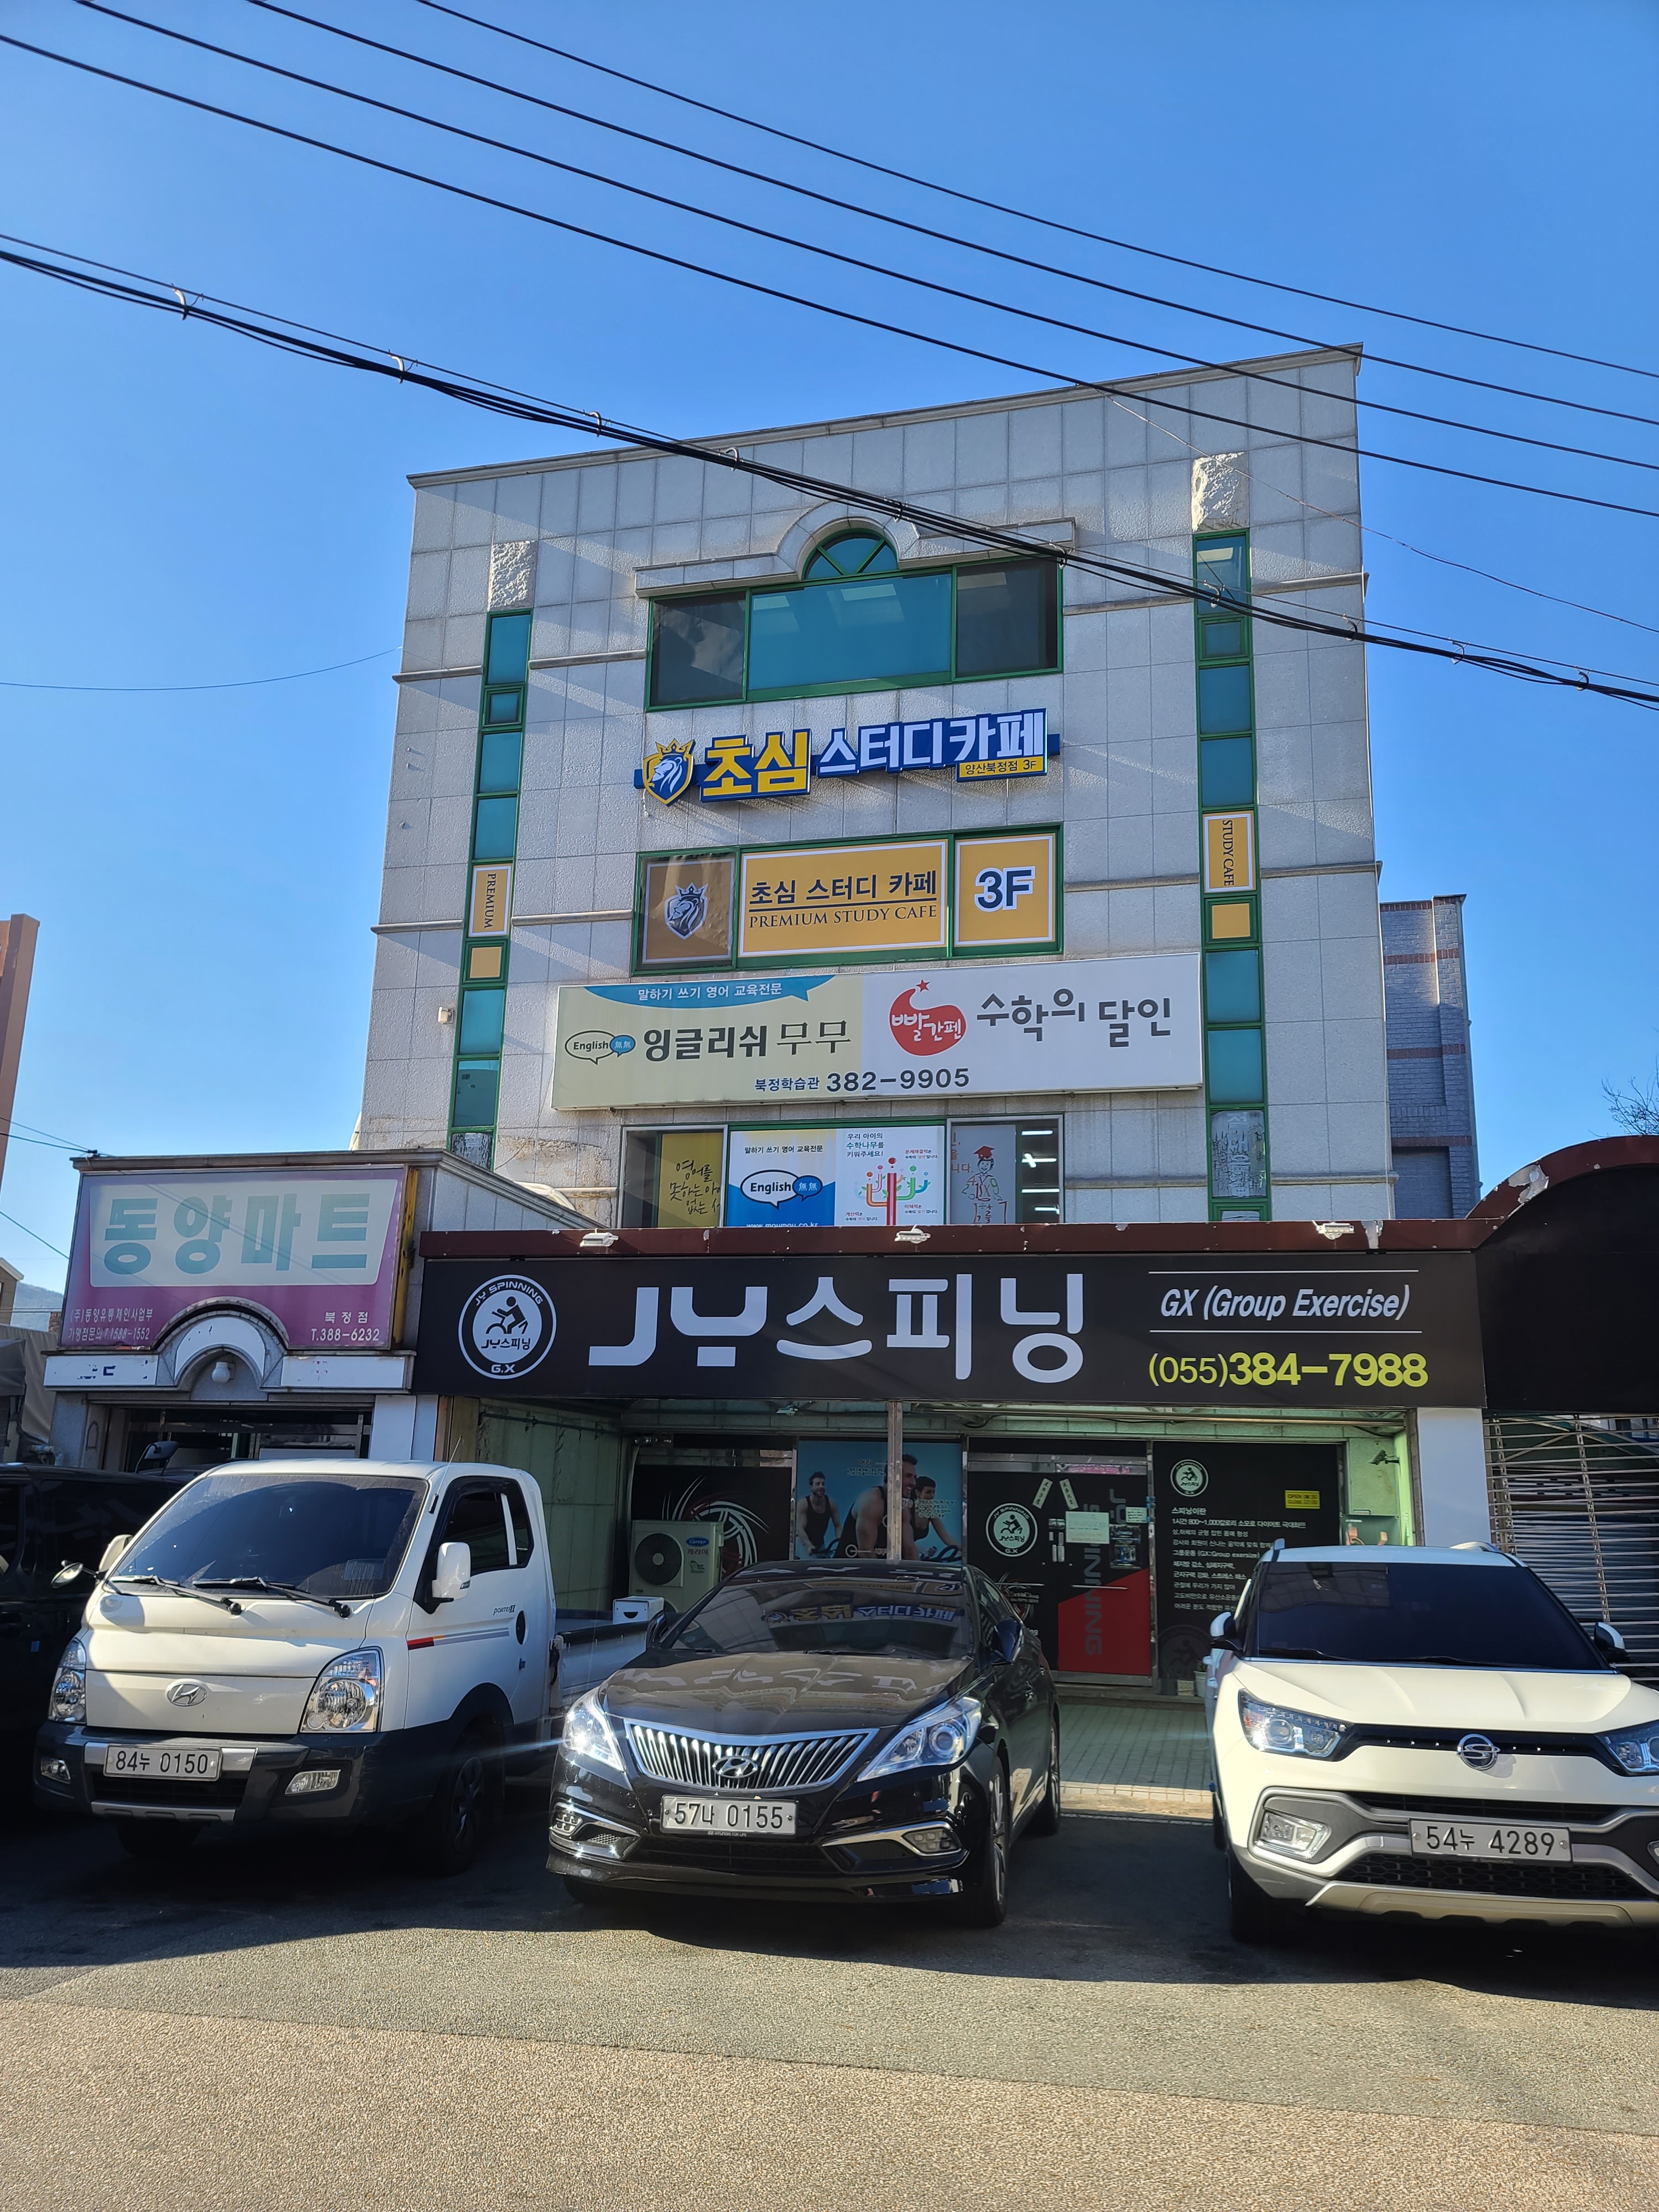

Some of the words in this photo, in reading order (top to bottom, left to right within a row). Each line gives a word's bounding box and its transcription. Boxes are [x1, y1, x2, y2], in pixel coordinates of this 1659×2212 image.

[702, 732, 808, 797] 초심
[966, 760, 1018, 775] 양산북정점
[1023, 759, 1036, 770] 3F
[1222, 820, 1234, 857] STUDY
[1223, 858, 1234, 886] CAFE
[749, 881, 795, 905] 초심
[806, 874, 877, 901] 스터디
[889, 870, 937, 896] 카페
[975, 866, 1035, 912] 3F
[484, 873, 497, 929] PREMIUM
[749, 912, 829, 930] PREMIUM
[834, 907, 891, 926] STUDY
[894, 904, 937, 921] CAFE
[638, 988, 672, 1001] 말하기
[677, 986, 701, 999] 쓰기
[706, 985, 729, 998] 영어
[734, 983, 782, 997] 교육전문
[891, 1013, 962, 1041] 빨간펜
[977, 988, 1085, 1042] 수학의
[1098, 998, 1171, 1047] 달인
[573, 1040, 608, 1052] English
[614, 1040, 632, 1049] 無無
[644, 1025, 767, 1062] 잉글리쉬
[776, 1020, 851, 1056] 무무
[754, 1077, 820, 1092] 북정학습관
[826, 1068, 969, 1092] 382-9905
[676, 1160, 713, 1183] 영어를
[670, 1181, 703, 1201] 못하는
[750, 1182, 791, 1194] English
[799, 1182, 817, 1191] 無無
[686, 1198, 708, 1214] 없는
[104, 1193, 371, 1275] 동양마트
[476, 1291, 486, 1306] JY
[489, 1281, 543, 1305] SPINNING
[1161, 1288, 1199, 1317] GX
[1203, 1286, 1286, 1321] (Group
[1292, 1284, 1410, 1321] Exercise)
[311, 1328, 379, 1342] T.388-6232
[481, 1338, 531, 1350] JY스피닝
[492, 1364, 515, 1373] G.X
[1149, 1352, 1428, 1387] (055)384-7988
[116, 1750, 150, 1771] 84누
[160, 1752, 208, 1774] 0150
[674, 1803, 714, 1825] 57나
[727, 1804, 783, 1829] 0155
[1427, 1825, 1475, 1851] 54누
[1488, 1829, 1554, 1855] 4289
